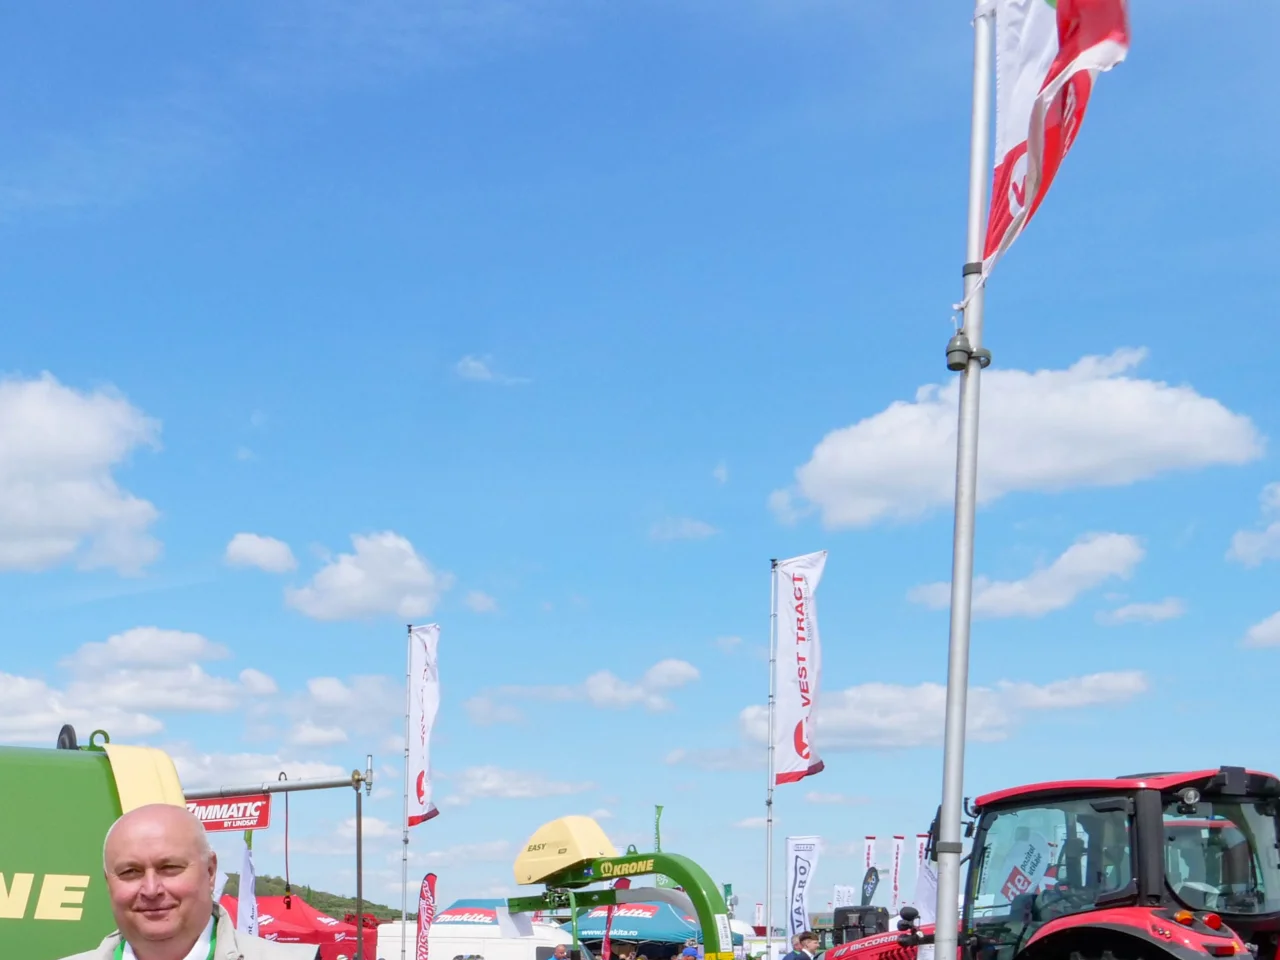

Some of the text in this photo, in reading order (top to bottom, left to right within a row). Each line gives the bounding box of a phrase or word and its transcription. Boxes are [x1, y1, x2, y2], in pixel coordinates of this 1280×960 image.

[792, 572, 811, 707] VEST TRACT
[612, 859, 654, 876] KRONE
[435, 913, 494, 924] makita
[588, 907, 653, 918] mkita
[850, 935, 898, 951] McCORM
